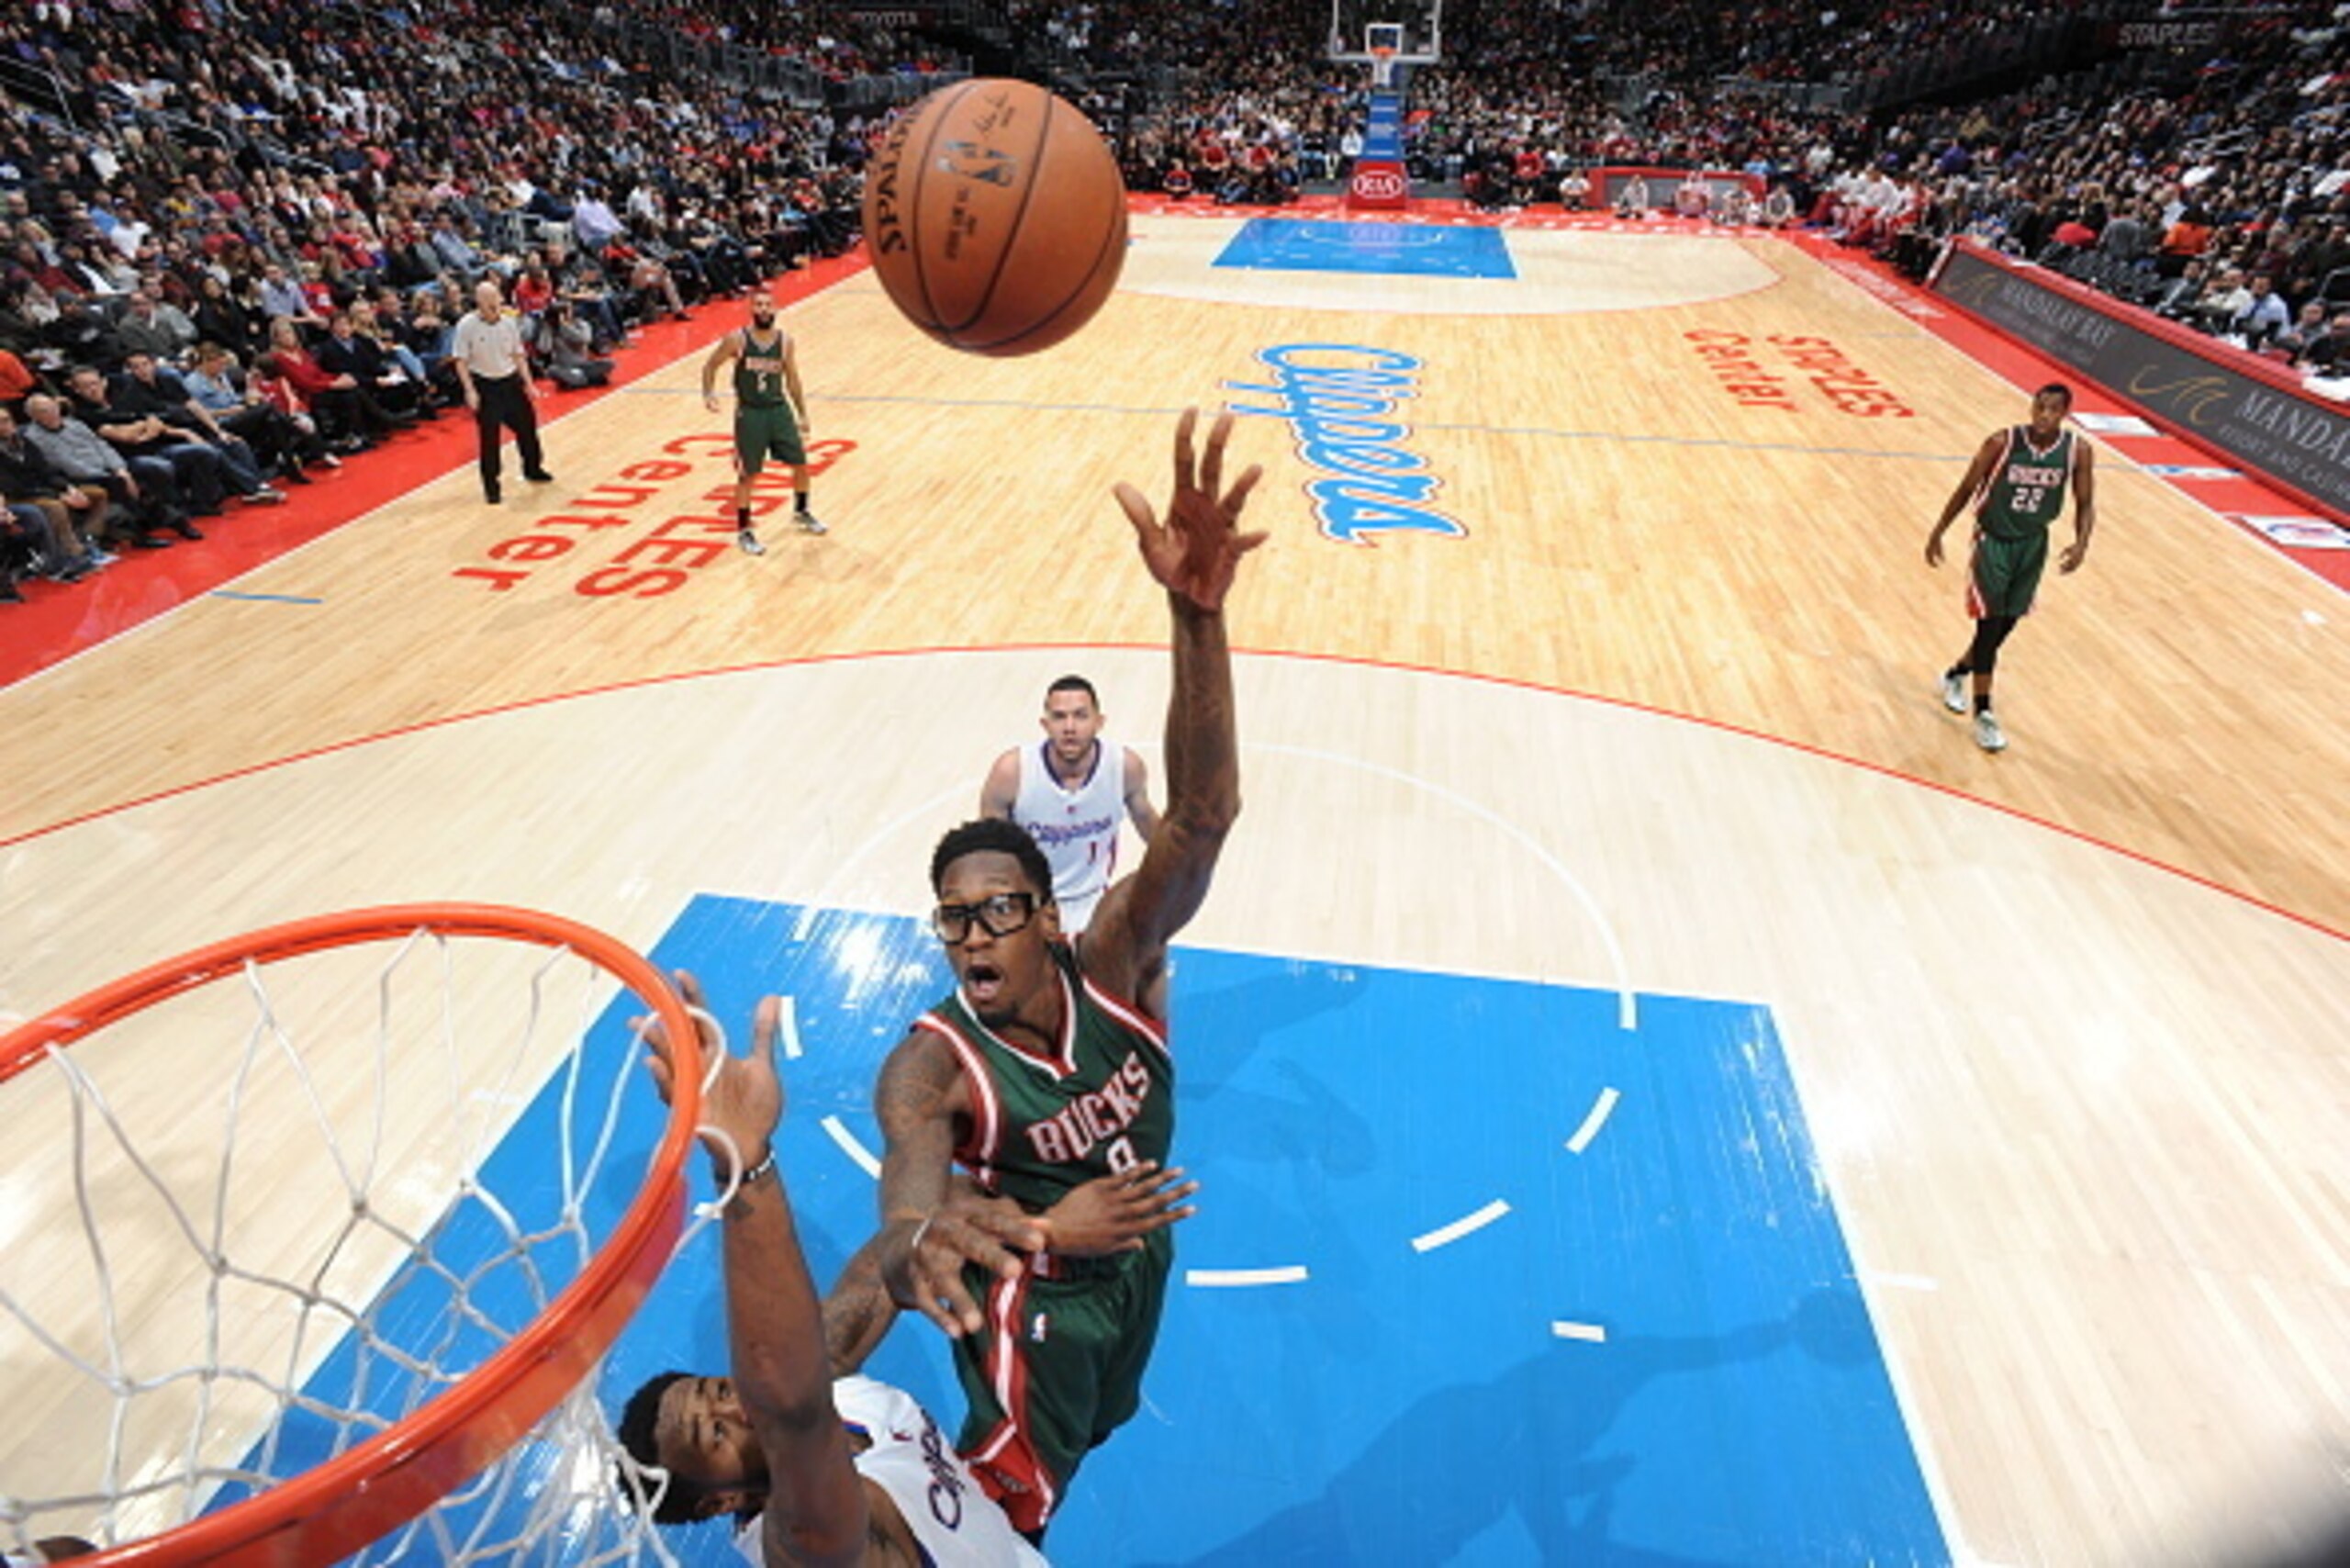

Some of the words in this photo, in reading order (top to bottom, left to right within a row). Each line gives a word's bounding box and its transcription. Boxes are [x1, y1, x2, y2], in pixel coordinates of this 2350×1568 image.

[2118, 22, 2217, 45] STAPLES
[2234, 388, 2350, 466] MANDA
[451, 433, 737, 591] Center
[1025, 1051, 1152, 1162] BUCKS
